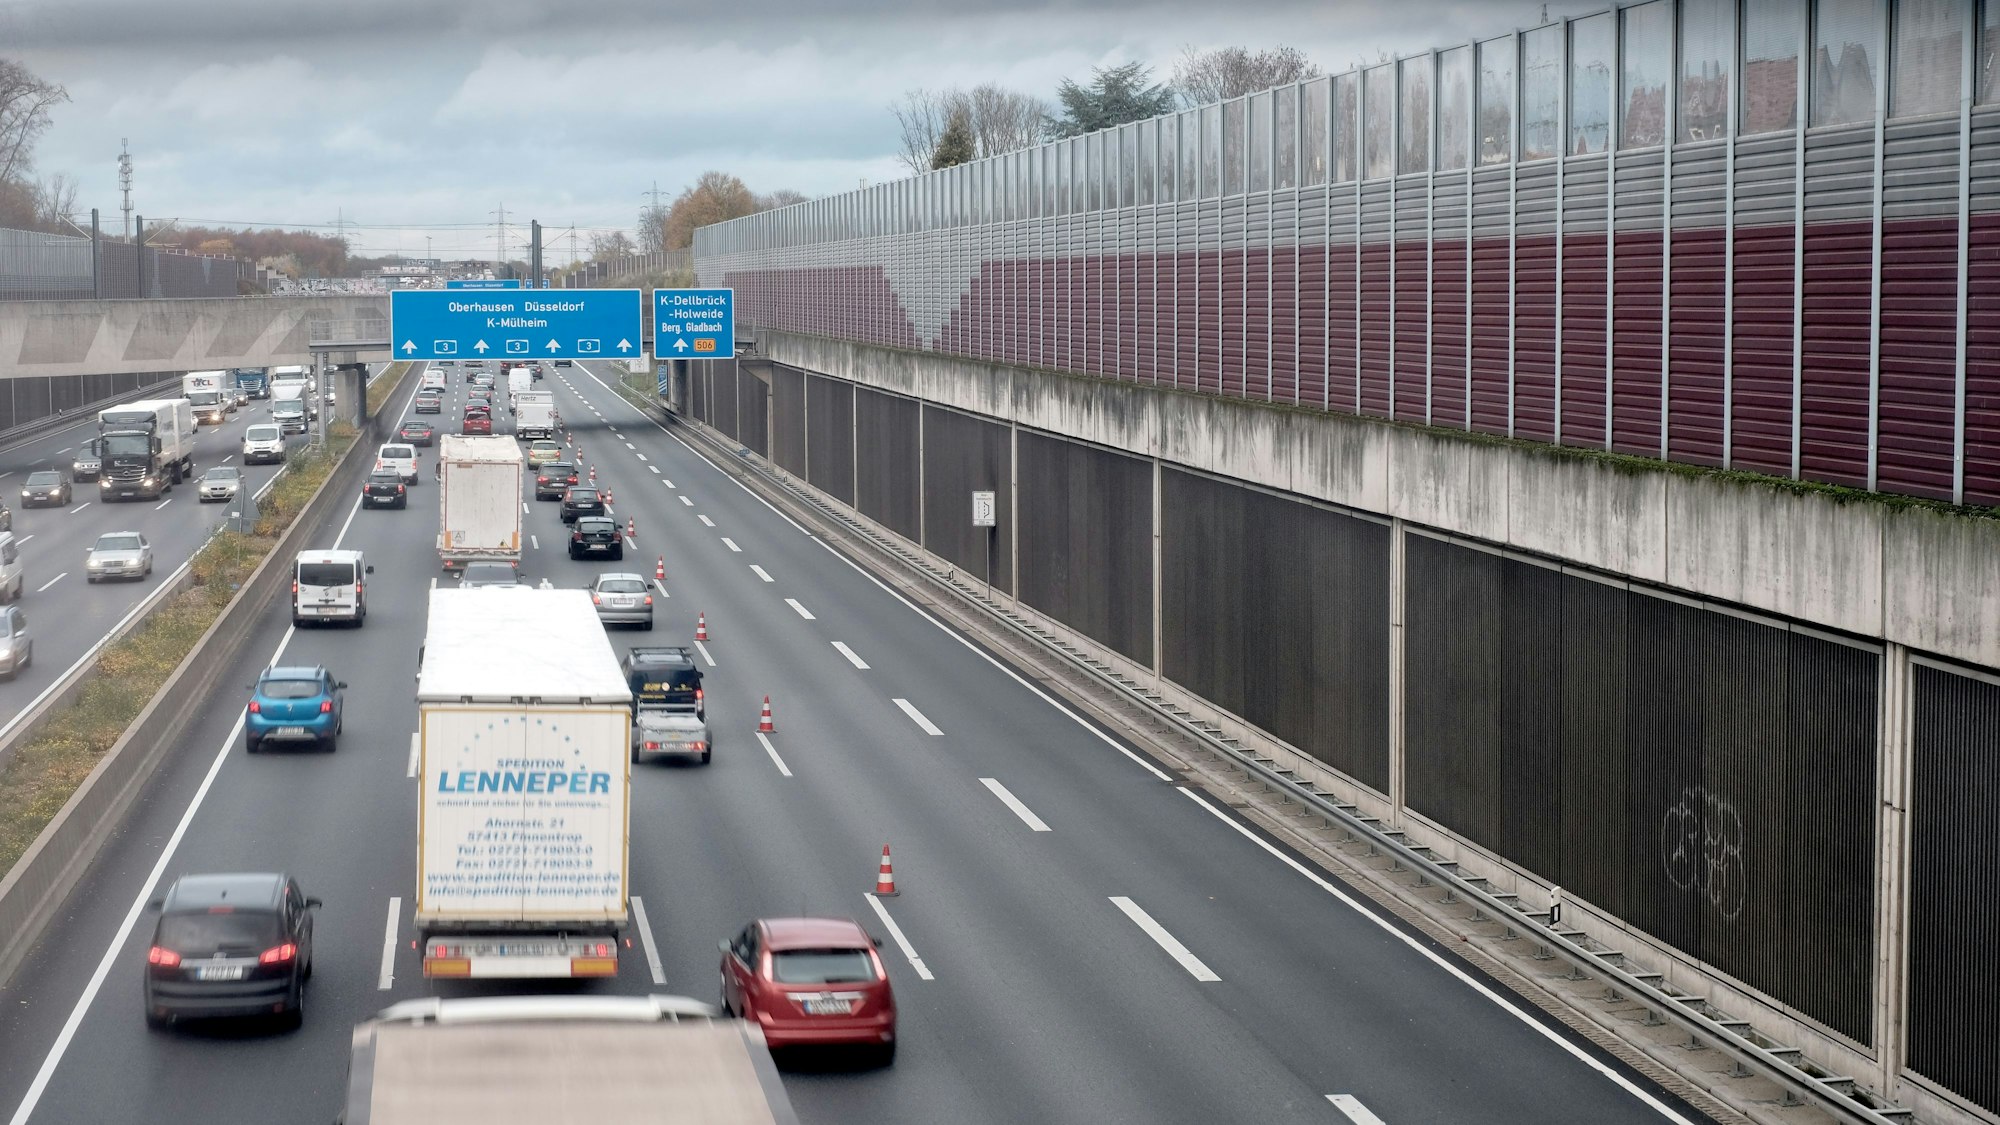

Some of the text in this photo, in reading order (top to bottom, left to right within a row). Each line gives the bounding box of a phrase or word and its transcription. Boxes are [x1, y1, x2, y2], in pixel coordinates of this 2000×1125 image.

[660, 295, 726, 306] K-Dellbrück
[448, 301, 585, 312] Oberhausen Düsseldorf
[668, 309, 724, 319] -Holweide
[487, 318, 548, 328] K-Mülheim
[662, 322, 723, 335] Berg. Gladbach
[442, 342, 449, 351] 3
[514, 342, 521, 351] 3
[586, 341, 592, 350] 3
[697, 341, 713, 350] 506
[496, 758, 565, 768] SPEDITION
[438, 771, 612, 793] LENNEPER
[472, 798, 490, 807] und
[467, 831, 508, 842] 57413
